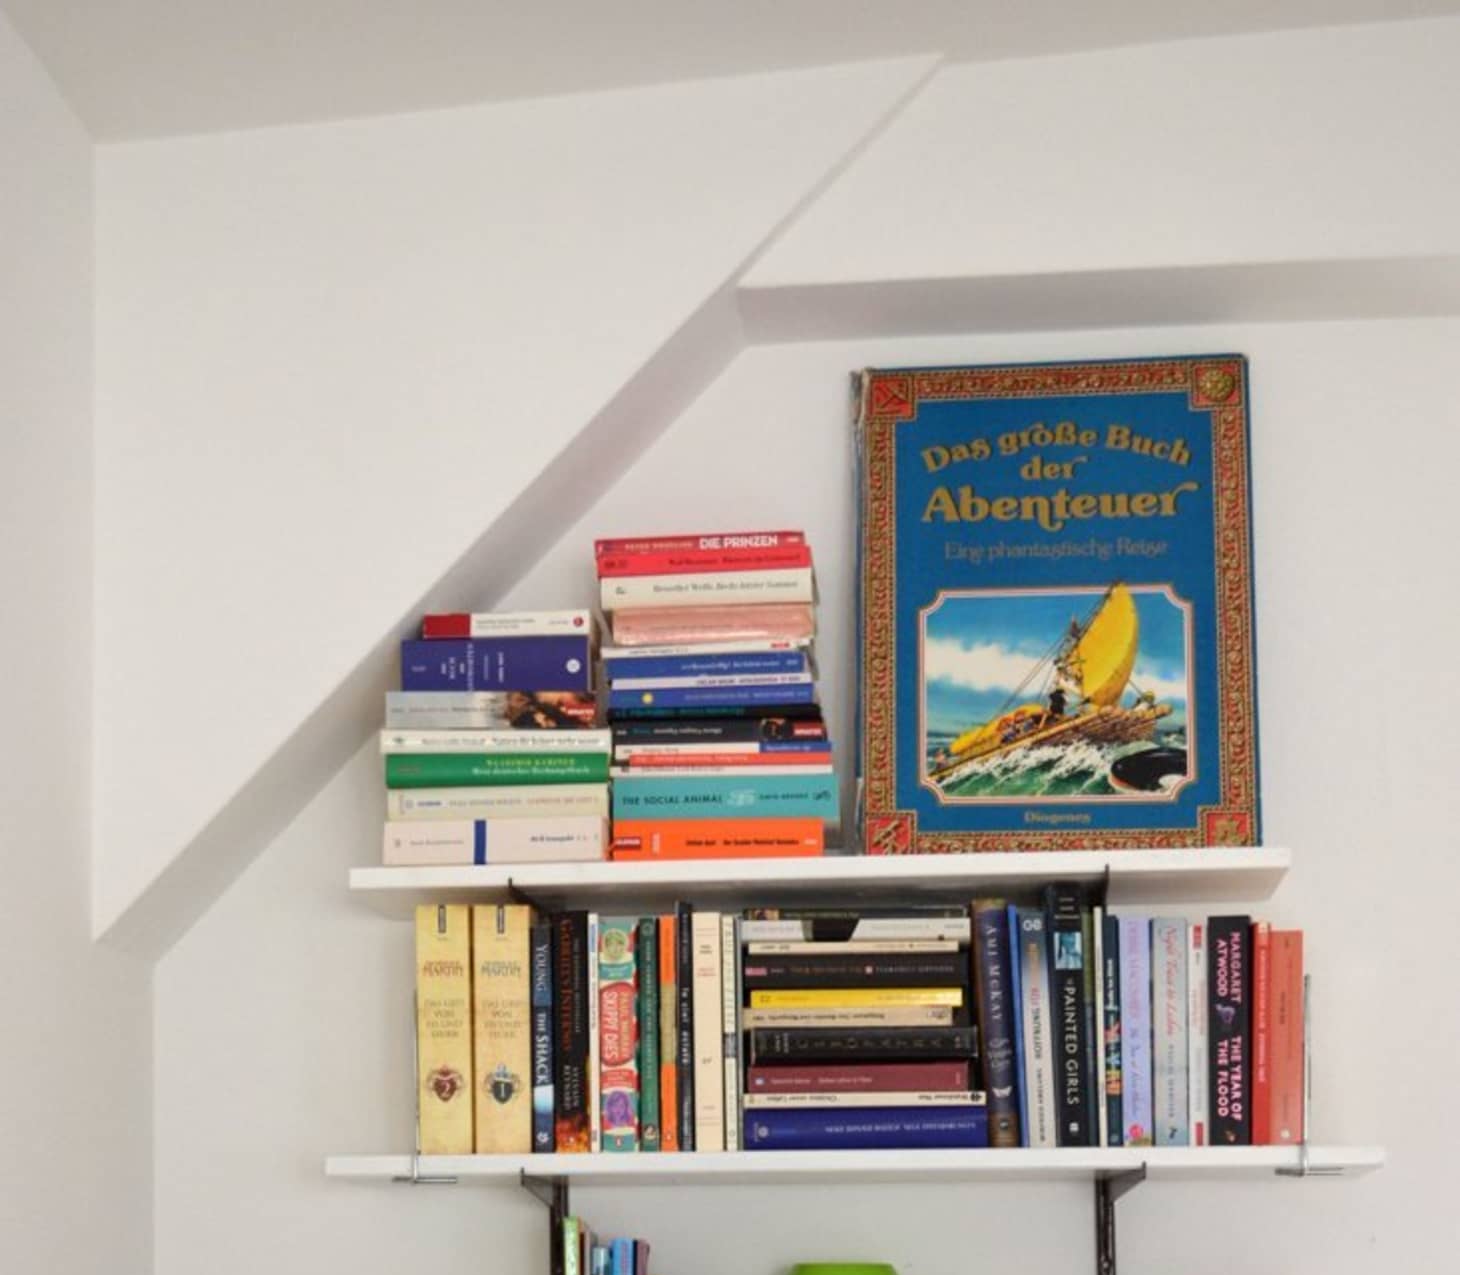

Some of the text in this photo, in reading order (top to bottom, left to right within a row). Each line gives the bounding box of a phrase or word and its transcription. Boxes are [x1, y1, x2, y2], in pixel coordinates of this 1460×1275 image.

[921, 421, 1191, 473] Das große Buch
[1020, 455, 1088, 480] der
[921, 481, 1199, 532] Abenteuer
[724, 535, 778, 549] PRINZEN
[536, 943, 550, 992] YOUNG
[1217, 939, 1228, 997] ATWOOD
[1230, 931, 1242, 1003] MARGARET
[536, 1034, 550, 1085] SHACK
[1064, 987, 1080, 1105] PAINTED GIRLS
[1217, 1040, 1228, 1117] THE FLOOD
[1231, 1036, 1242, 1121] THE YEAR OF
